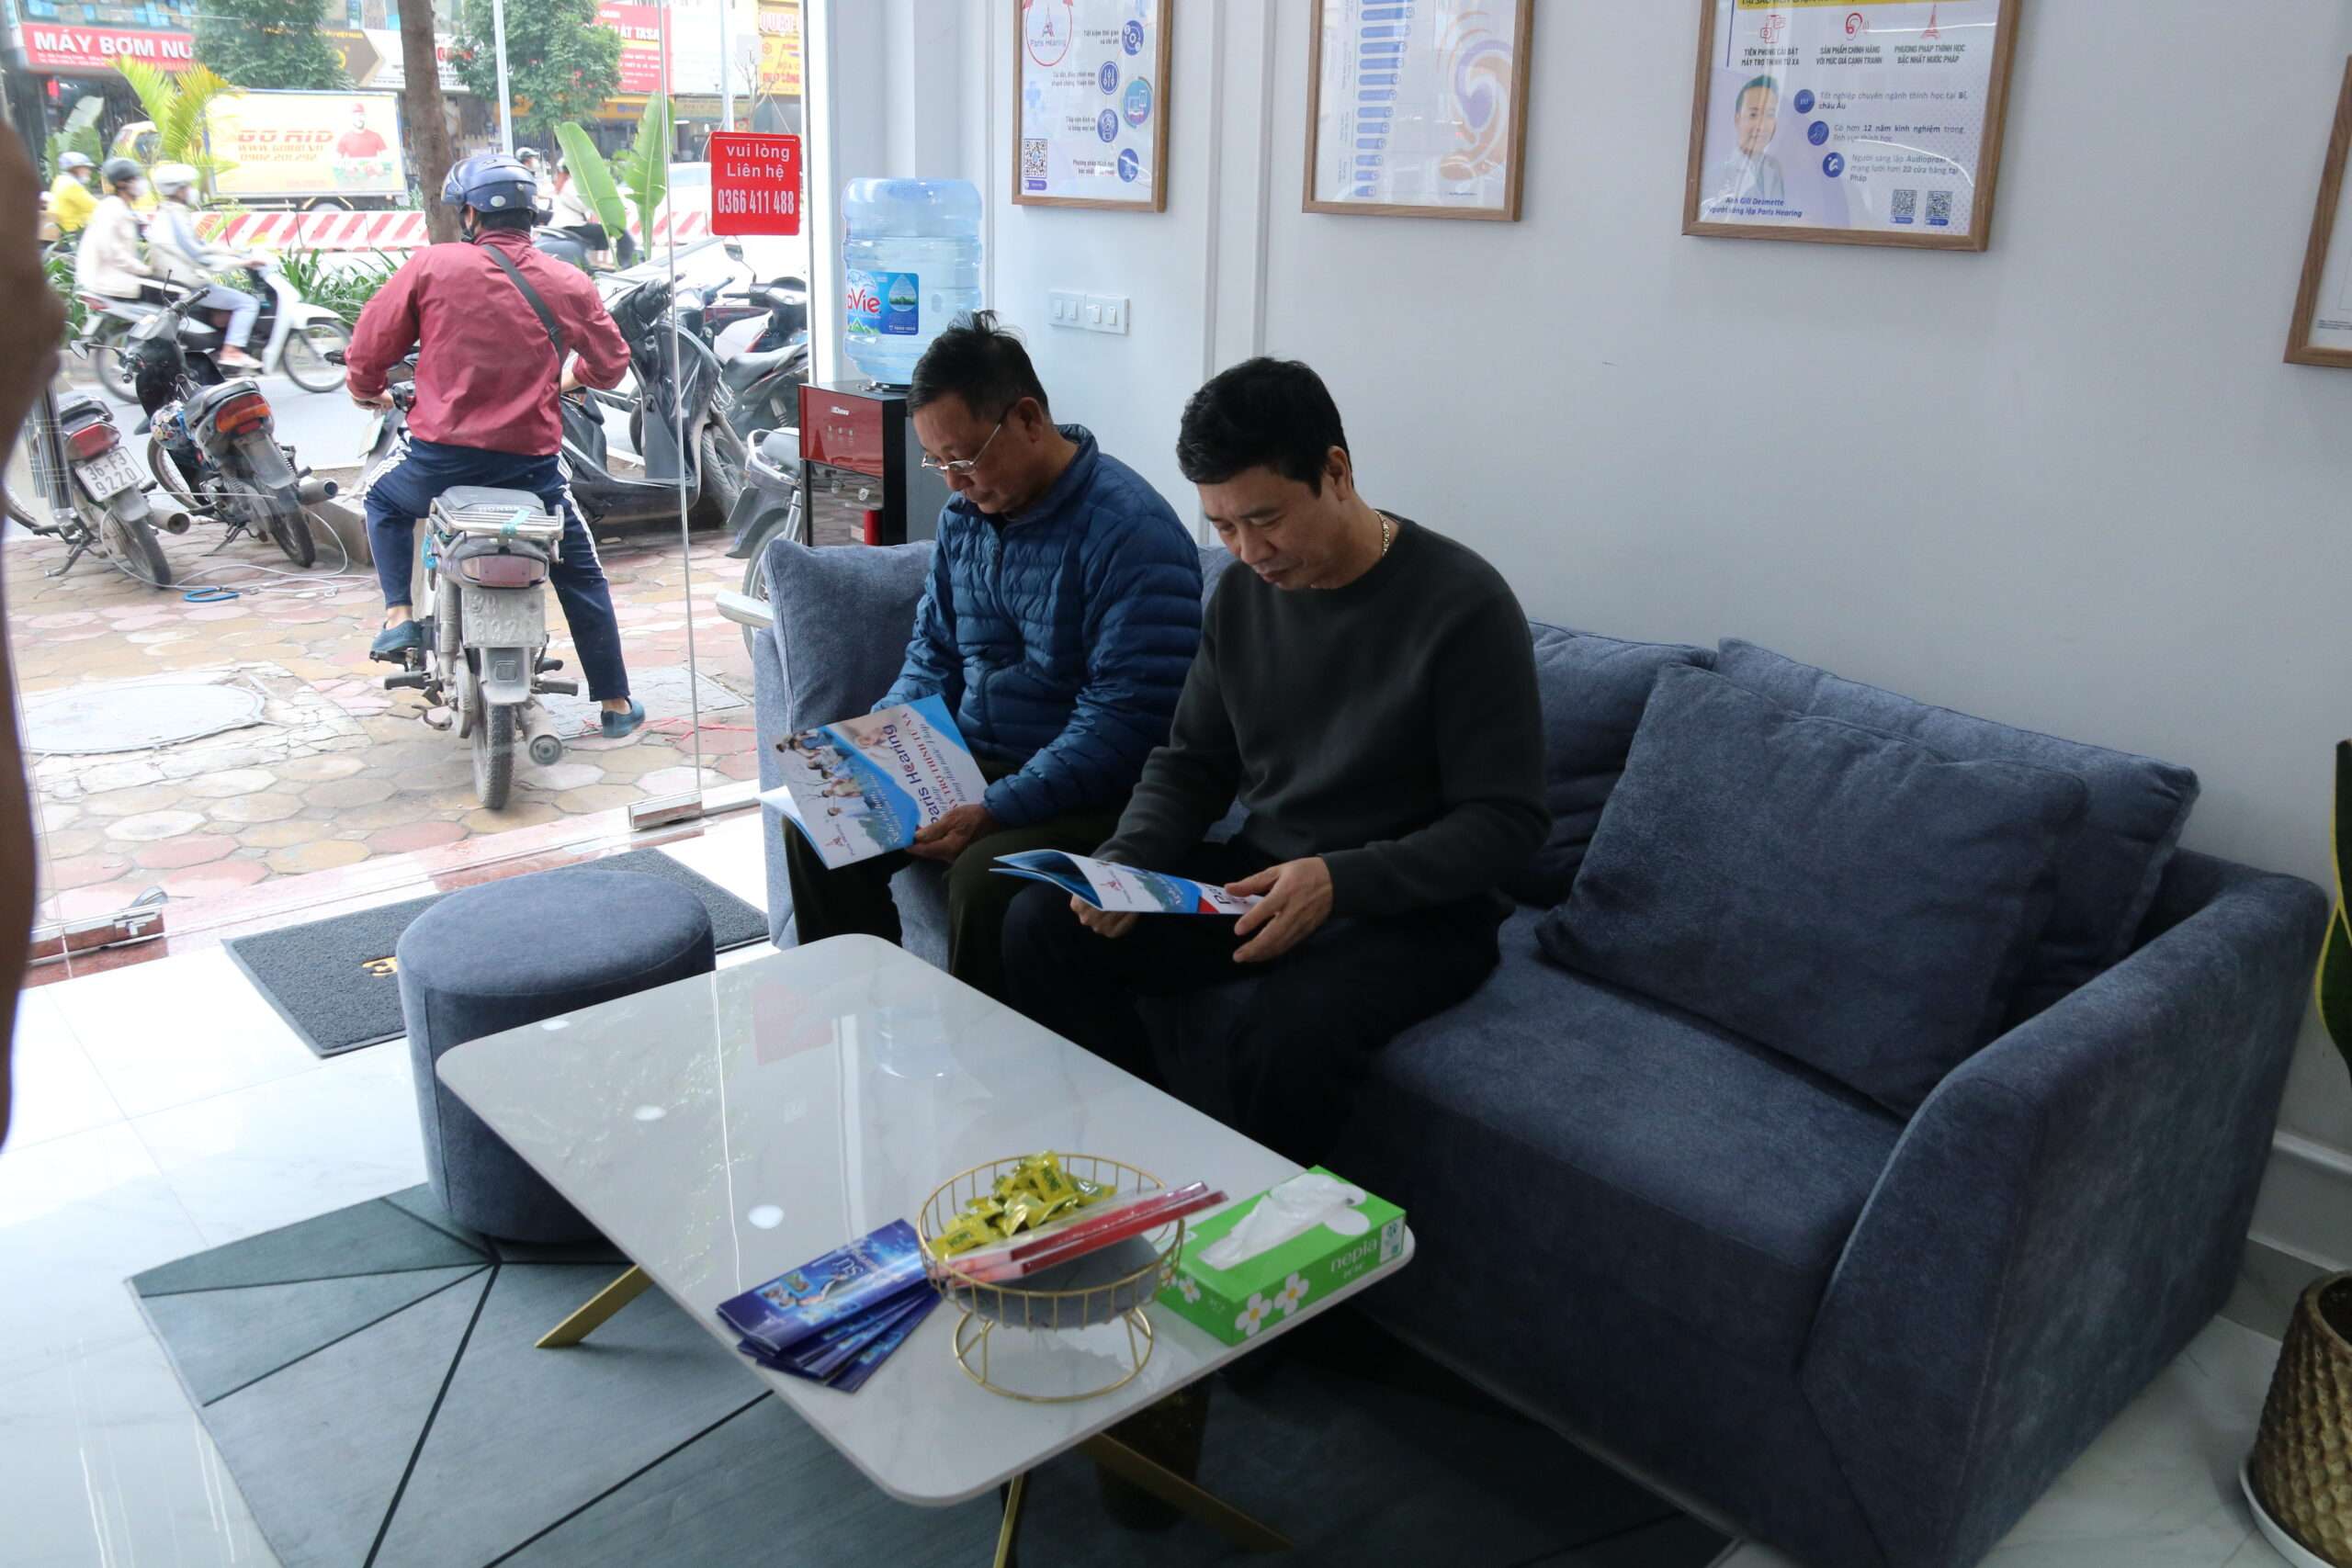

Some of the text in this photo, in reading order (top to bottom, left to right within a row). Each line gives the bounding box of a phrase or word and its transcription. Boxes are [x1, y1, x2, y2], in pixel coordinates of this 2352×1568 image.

[34, 28, 92, 53] MÁY
[98, 35, 155, 57] BƠM
[726, 143, 790, 162] vui lòng
[727, 163, 784, 181] Liên hệ
[718, 188, 795, 215] 0366 411 488
[847, 288, 881, 314] aVie
[95, 467, 138, 496] 9220
[882, 724, 922, 785] Hearing
